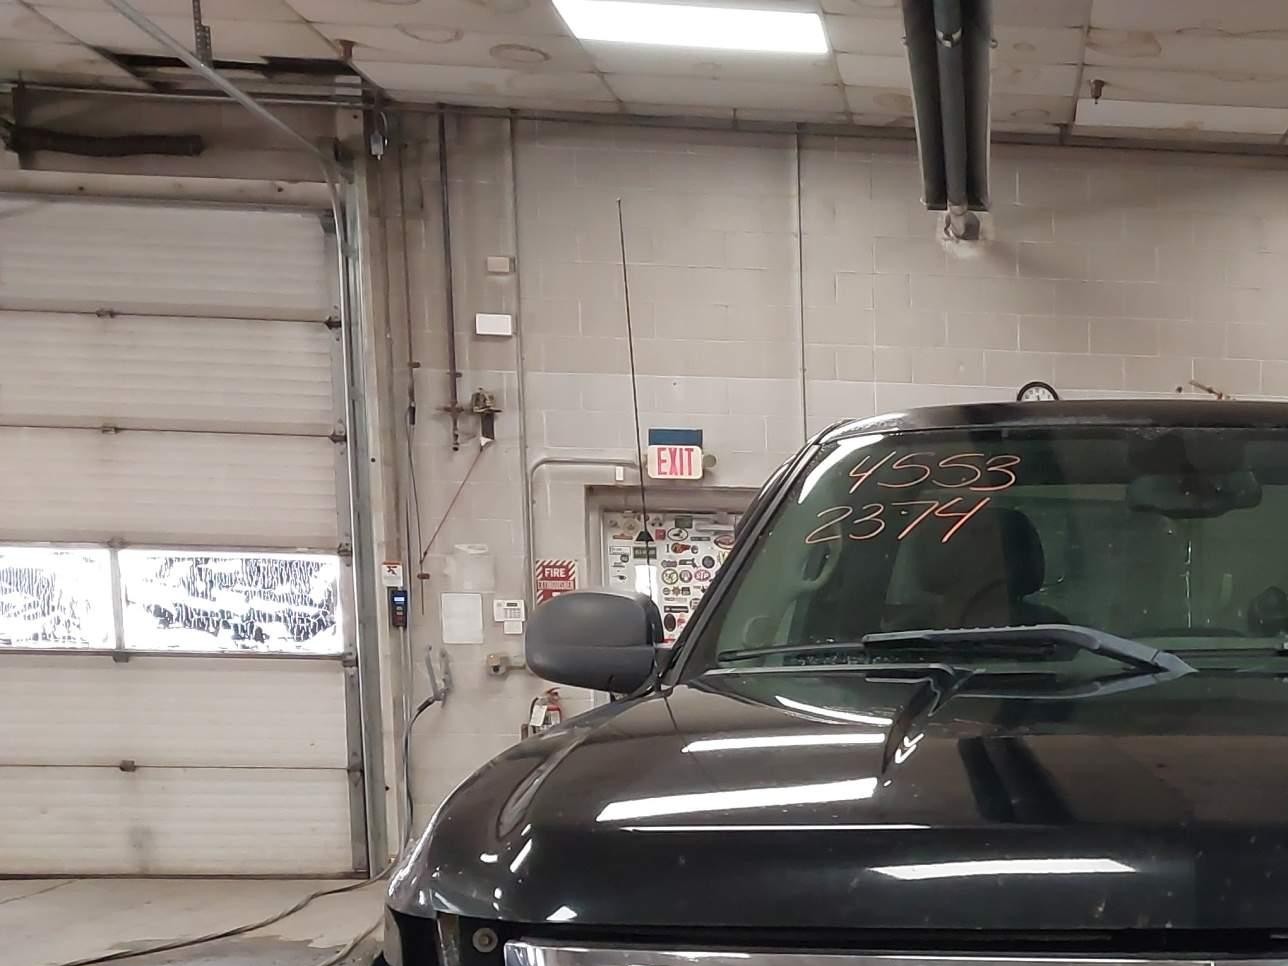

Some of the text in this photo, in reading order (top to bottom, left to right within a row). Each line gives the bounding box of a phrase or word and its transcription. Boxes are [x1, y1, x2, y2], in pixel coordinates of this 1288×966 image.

[657, 447, 694, 476] EXIT
[848, 451, 1021, 494] 4553
[805, 497, 990, 544] 2374
[544, 567, 567, 578] FIRE
